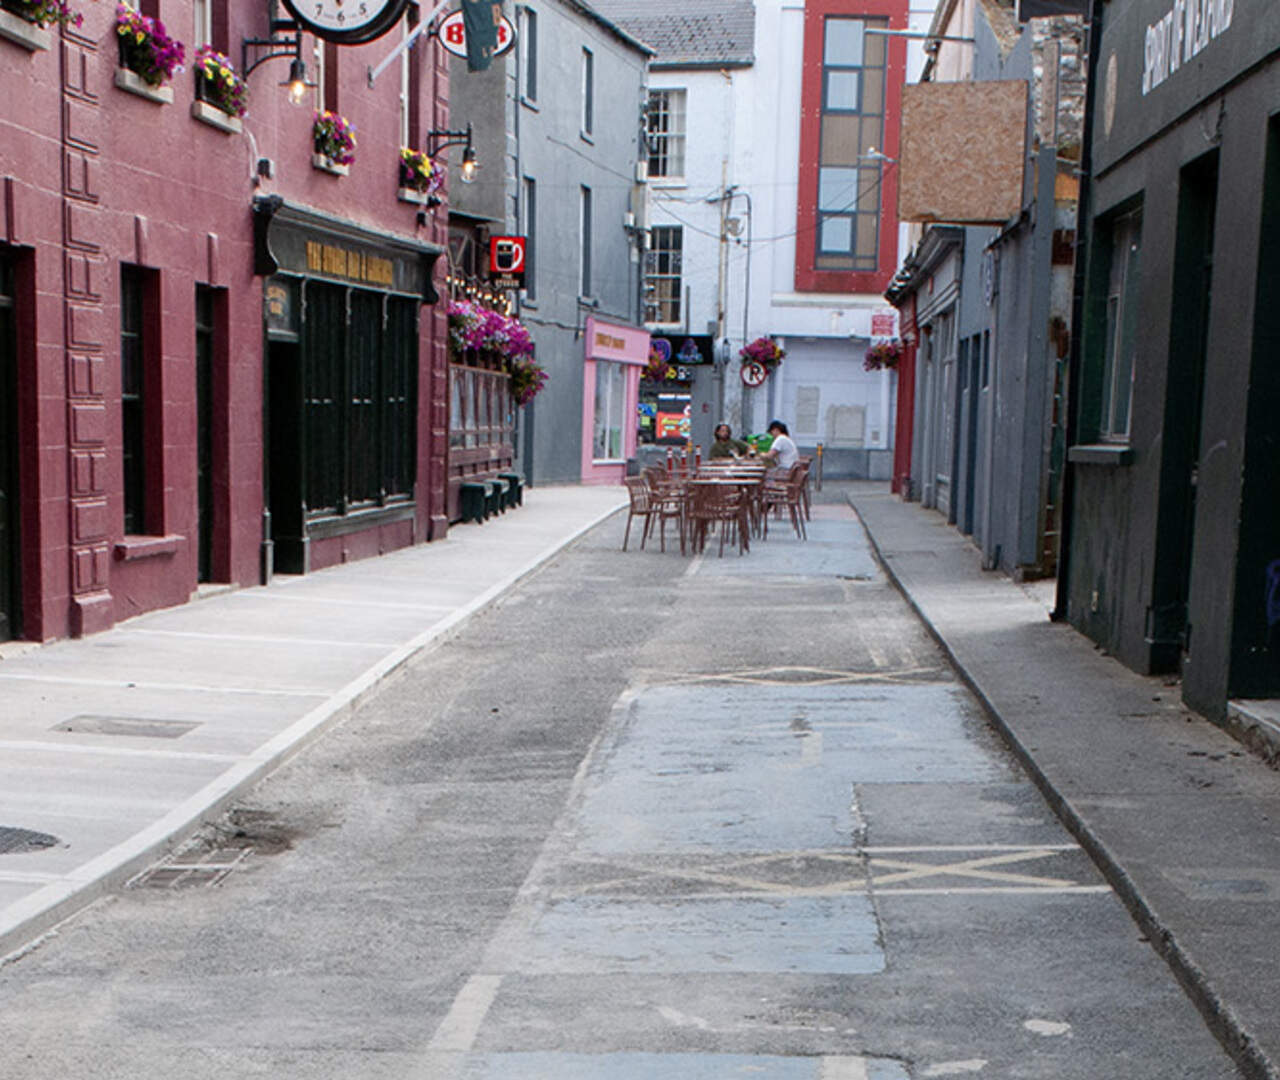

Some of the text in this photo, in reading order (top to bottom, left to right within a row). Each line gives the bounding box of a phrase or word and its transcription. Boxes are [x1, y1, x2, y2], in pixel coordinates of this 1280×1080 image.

[316, 3, 322, 15] 7
[360, 3, 367, 15] 5
[337, 11, 345, 21] 6
